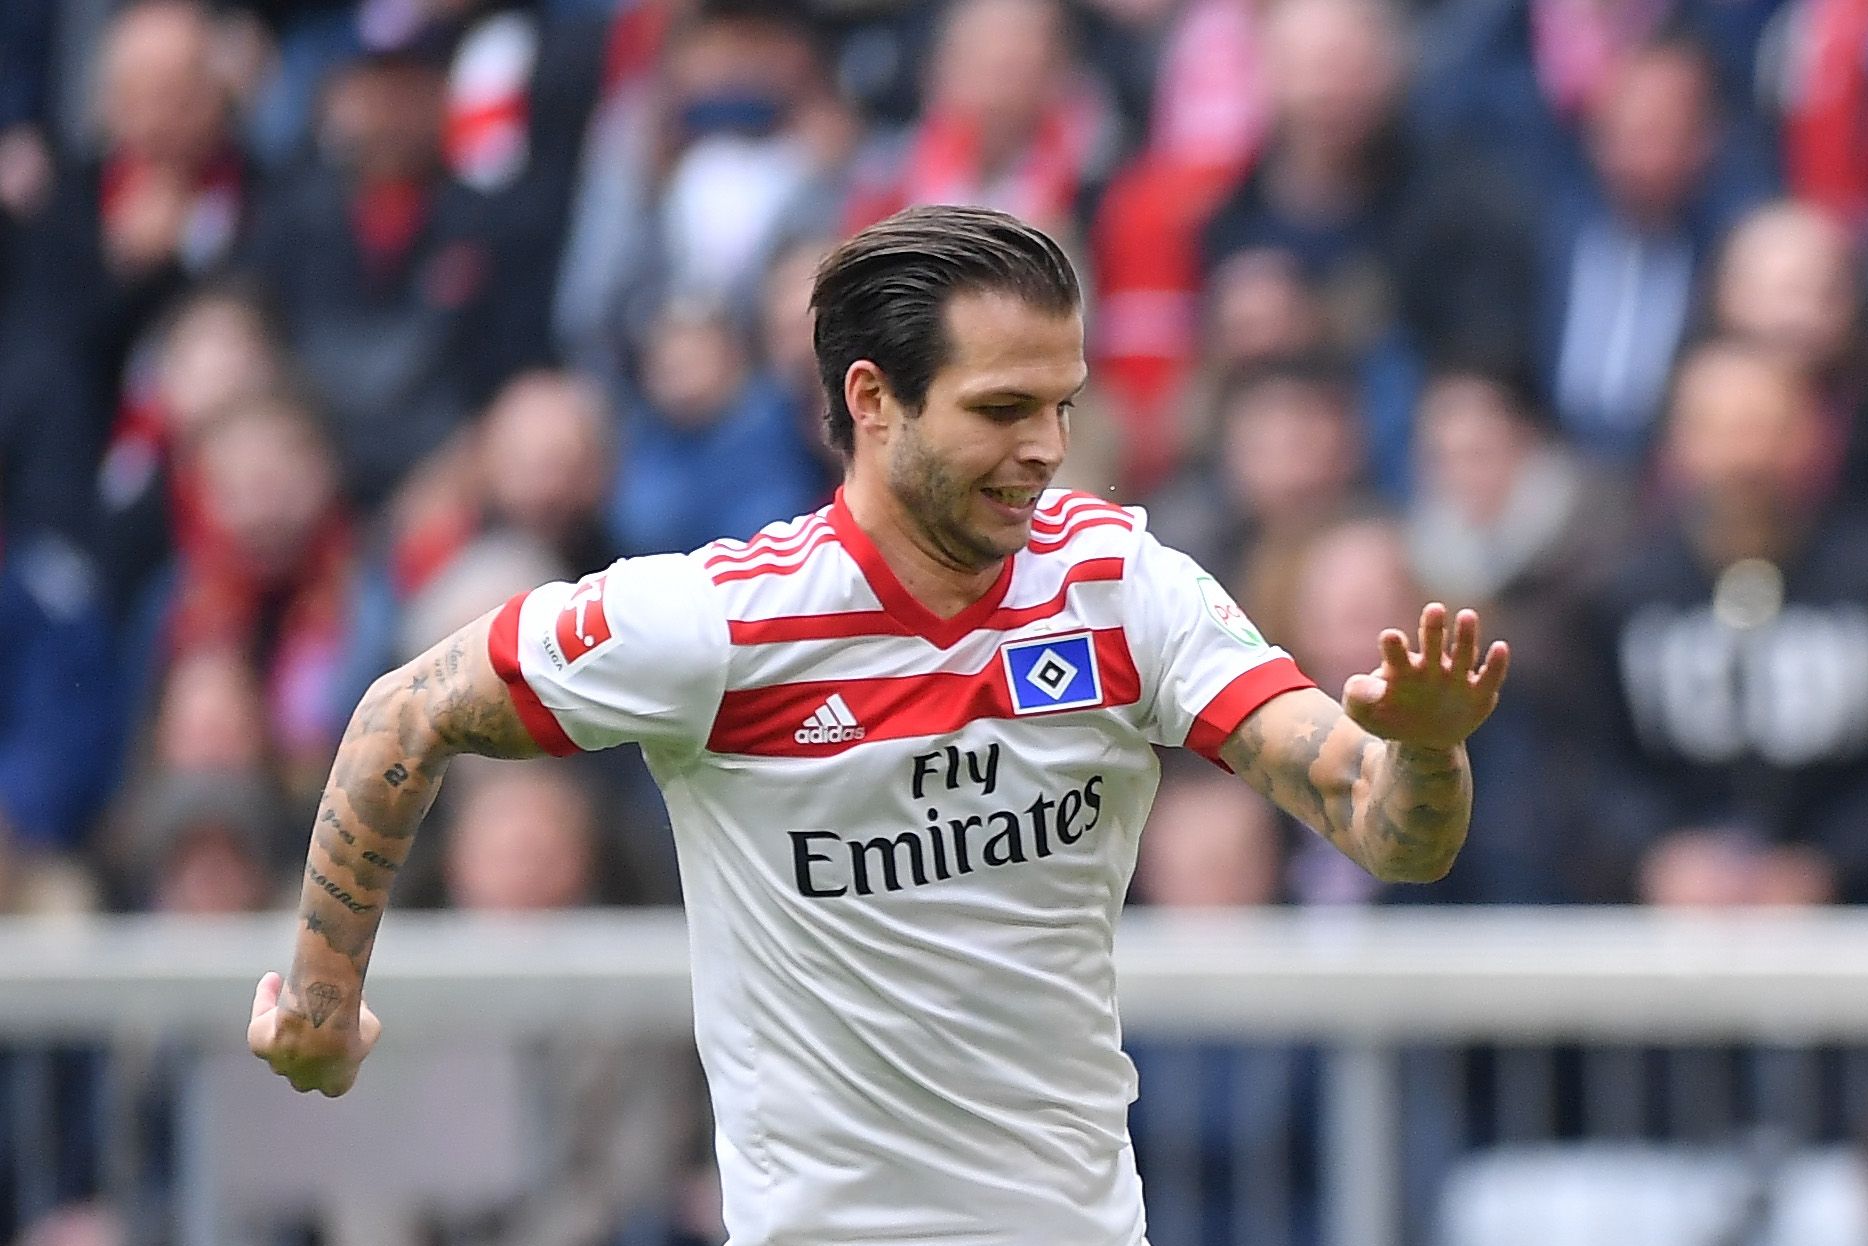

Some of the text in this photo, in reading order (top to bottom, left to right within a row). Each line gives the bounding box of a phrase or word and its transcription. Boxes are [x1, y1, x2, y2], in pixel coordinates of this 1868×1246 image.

[794, 726, 866, 744] adidas
[911, 743, 999, 800] Fly
[786, 775, 1103, 898] Emirates
